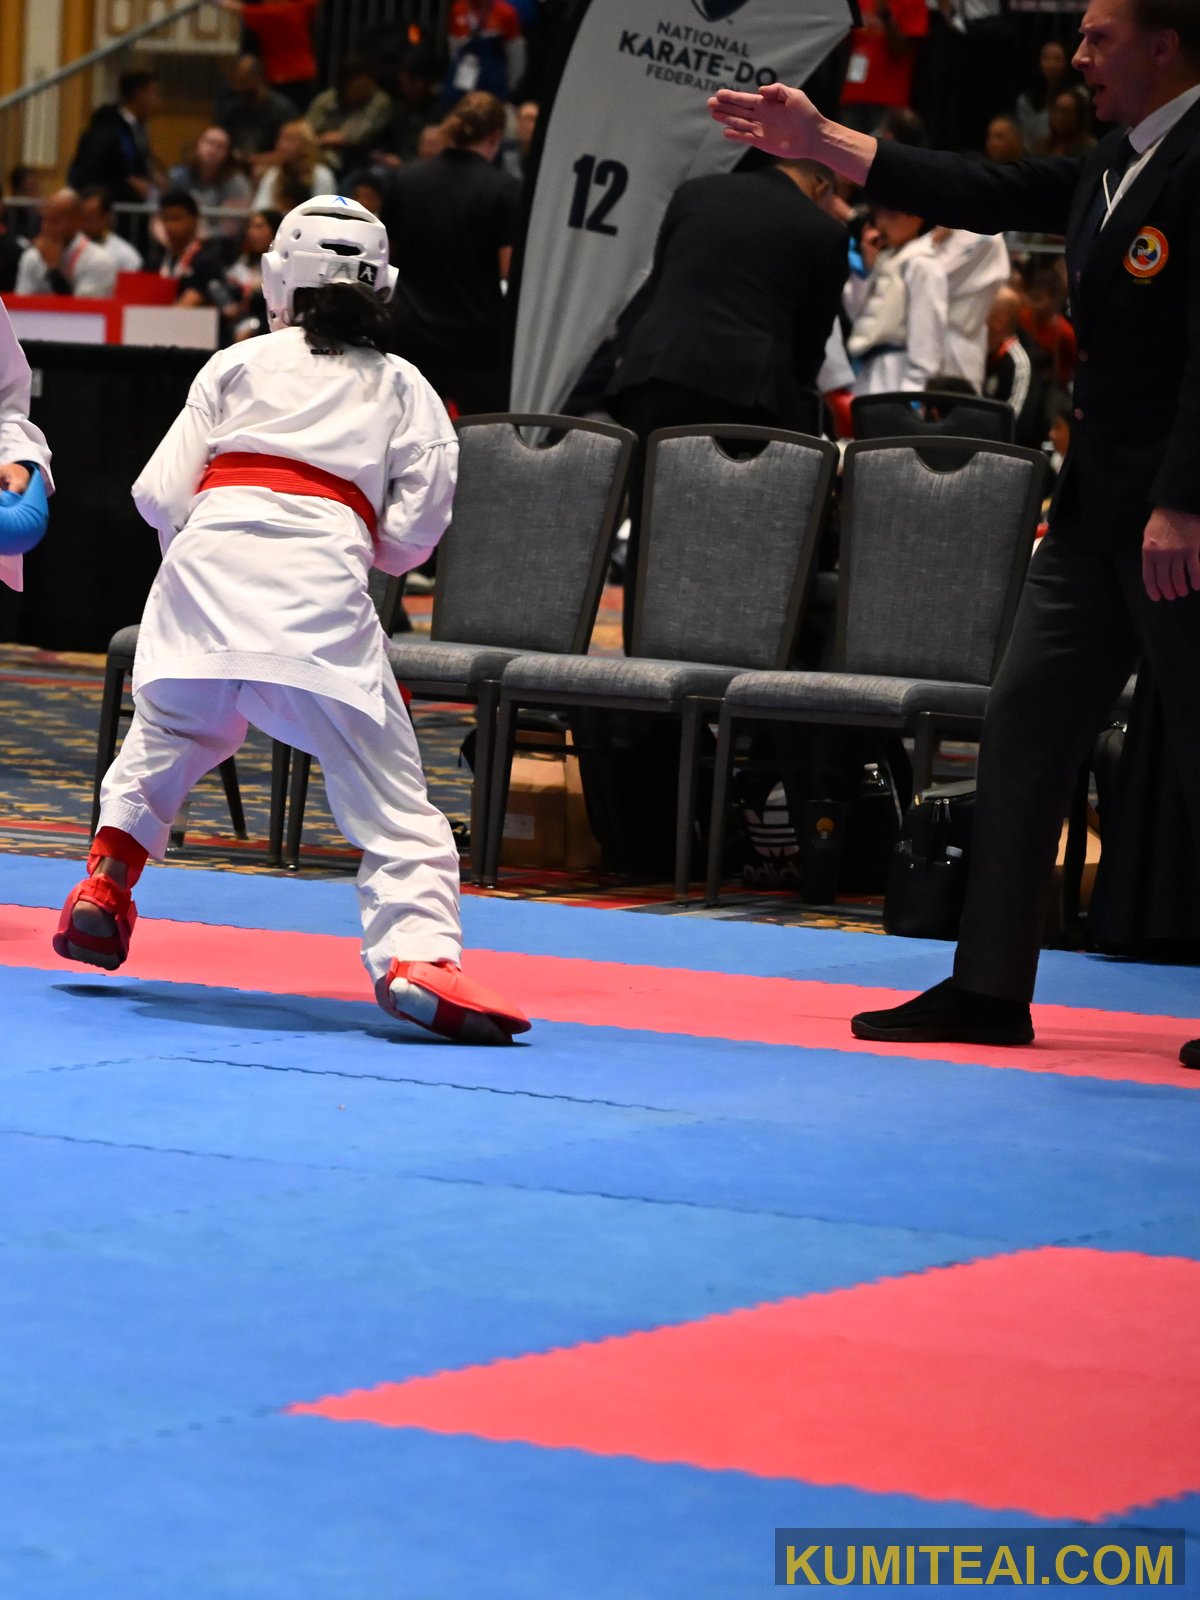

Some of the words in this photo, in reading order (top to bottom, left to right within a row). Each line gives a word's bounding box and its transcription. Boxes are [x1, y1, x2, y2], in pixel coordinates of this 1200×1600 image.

[619, 29, 778, 87] KARATE-DO
[657, 20, 750, 58] NATIONAL
[567, 153, 629, 237] 12
